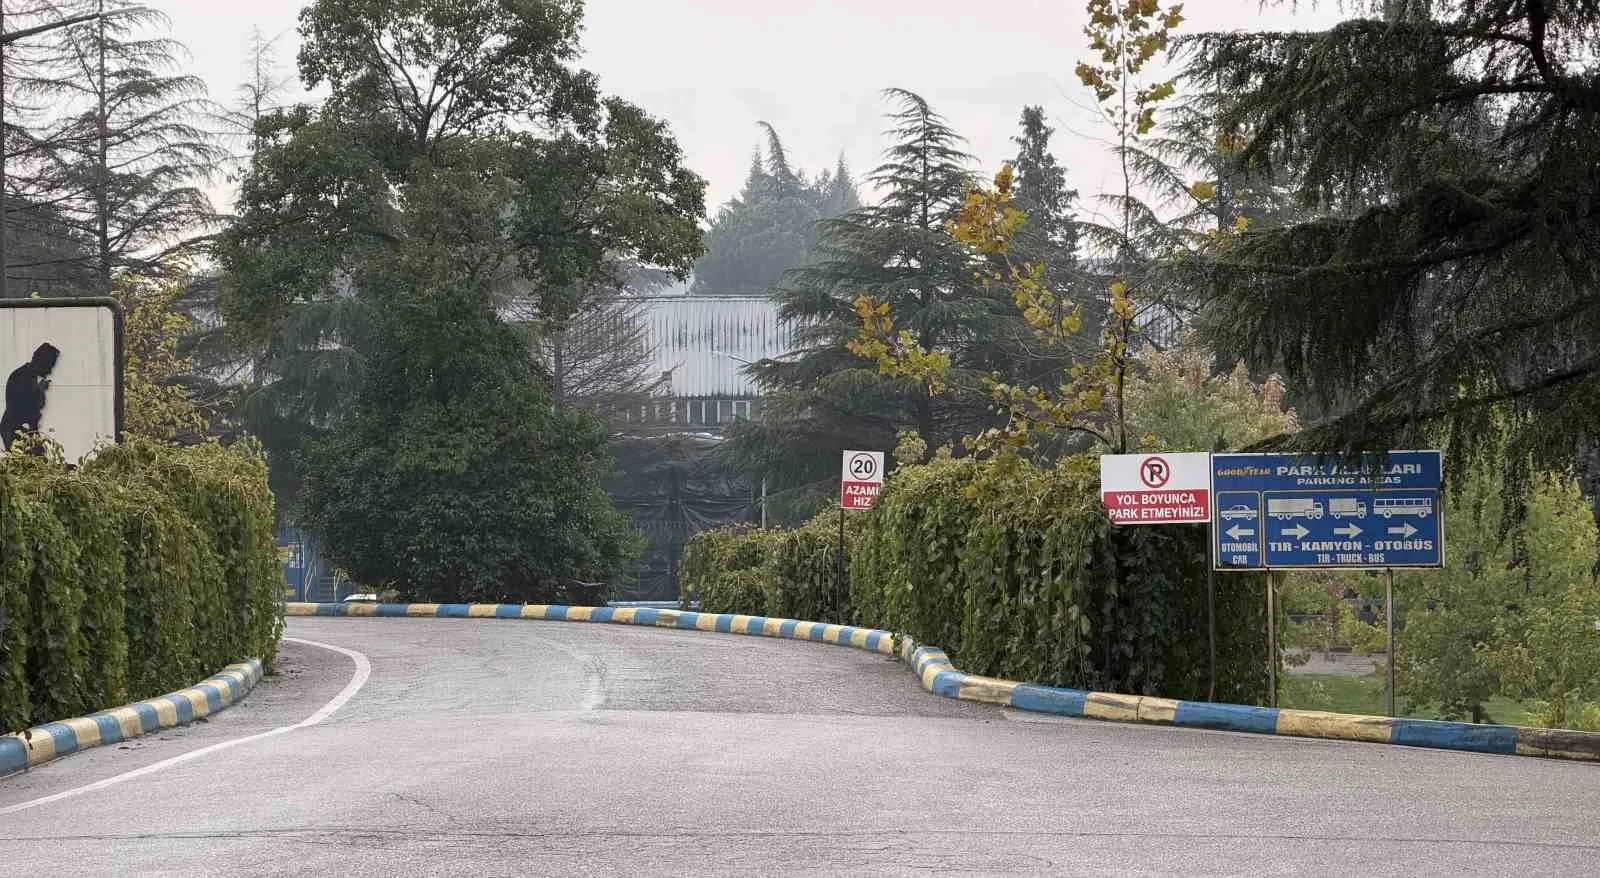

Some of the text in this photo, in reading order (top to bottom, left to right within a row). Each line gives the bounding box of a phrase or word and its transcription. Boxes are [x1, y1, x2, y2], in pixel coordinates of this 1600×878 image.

[854, 459, 873, 474] 20
[1276, 465, 1327, 476] PARK
[1296, 477, 1355, 485] PARKING
[853, 496, 872, 506] HIZ
[1116, 493, 1196, 505] YOL BOYUNCA
[1108, 505, 1204, 519] PARK ETMEYİNİZ!
[1301, 541, 1362, 551] KAMYON
[1374, 539, 1433, 550] OTOBÜS
[1232, 554, 1248, 566] CAR
[1336, 553, 1362, 563] TRUCK
[1368, 552, 1385, 562] BUS
